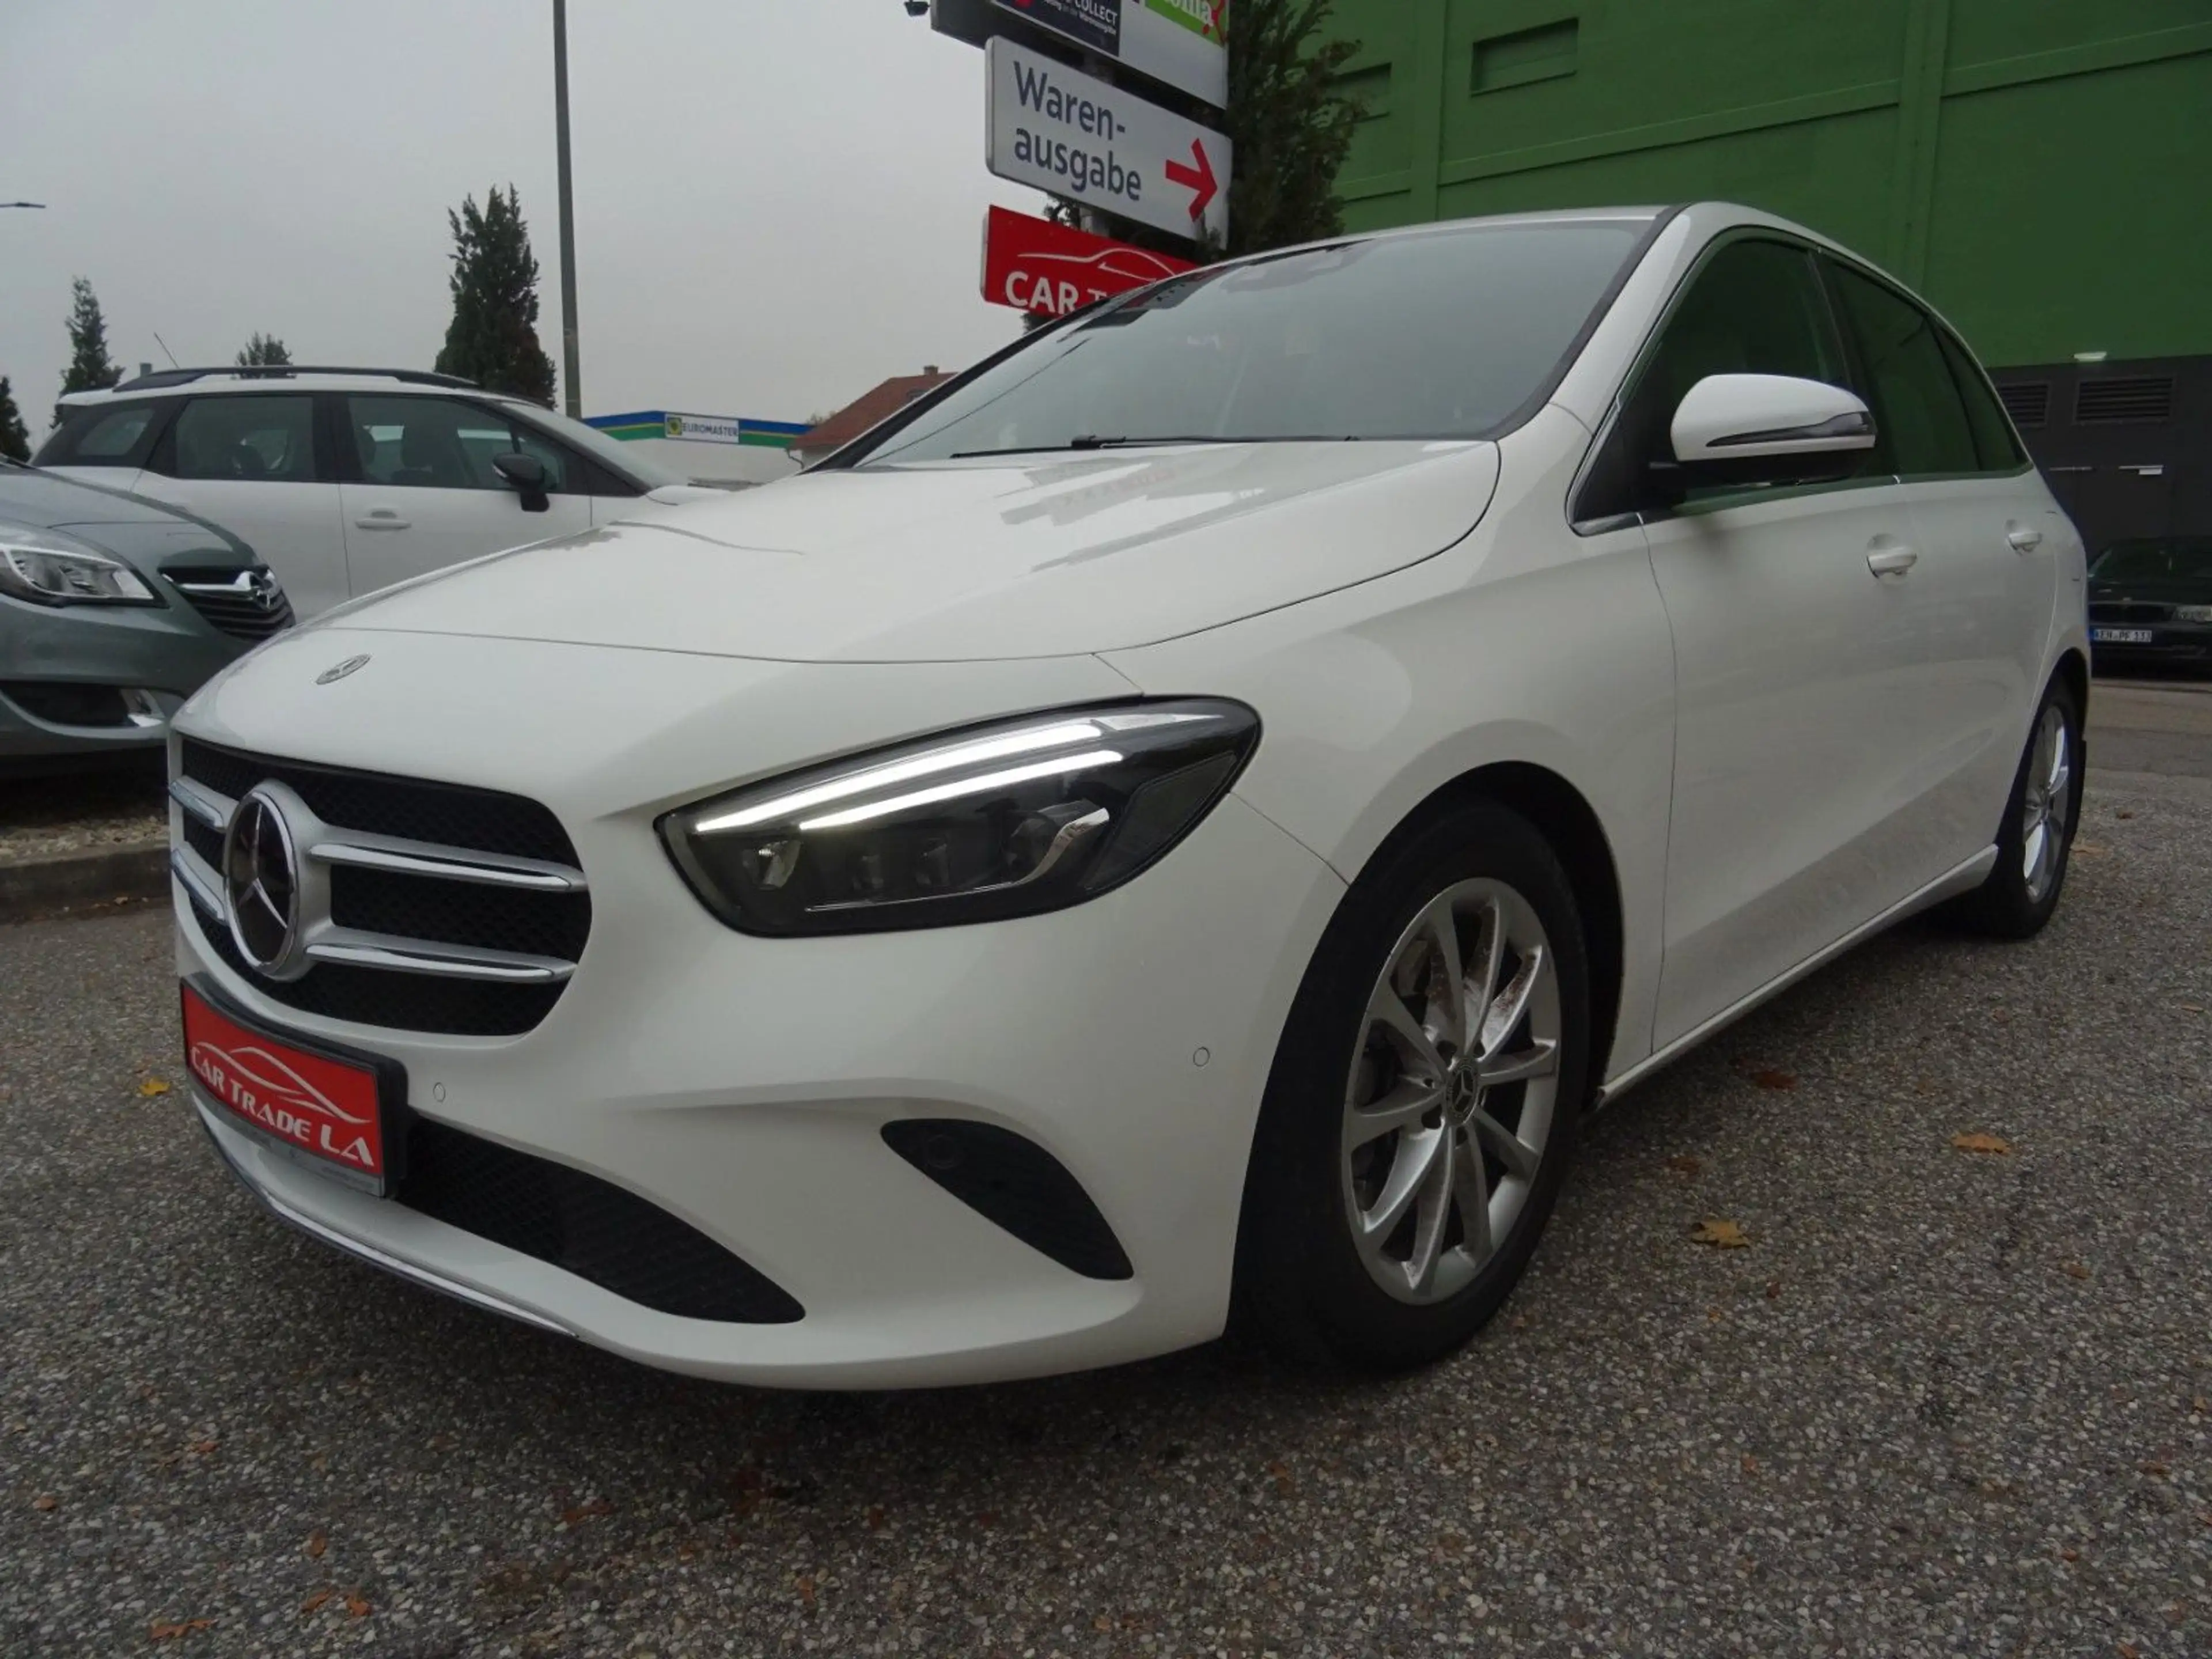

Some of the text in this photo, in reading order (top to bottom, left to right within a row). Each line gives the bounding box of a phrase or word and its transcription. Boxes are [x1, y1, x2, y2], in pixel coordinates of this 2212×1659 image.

[1014, 60, 1126, 142] Waren-
[1014, 127, 1142, 202] ausgabe
[1005, 270, 1080, 315] CAR
[682, 422, 738, 437] EUROMASTER
[190, 1046, 375, 1168] CAR TRADE LA
